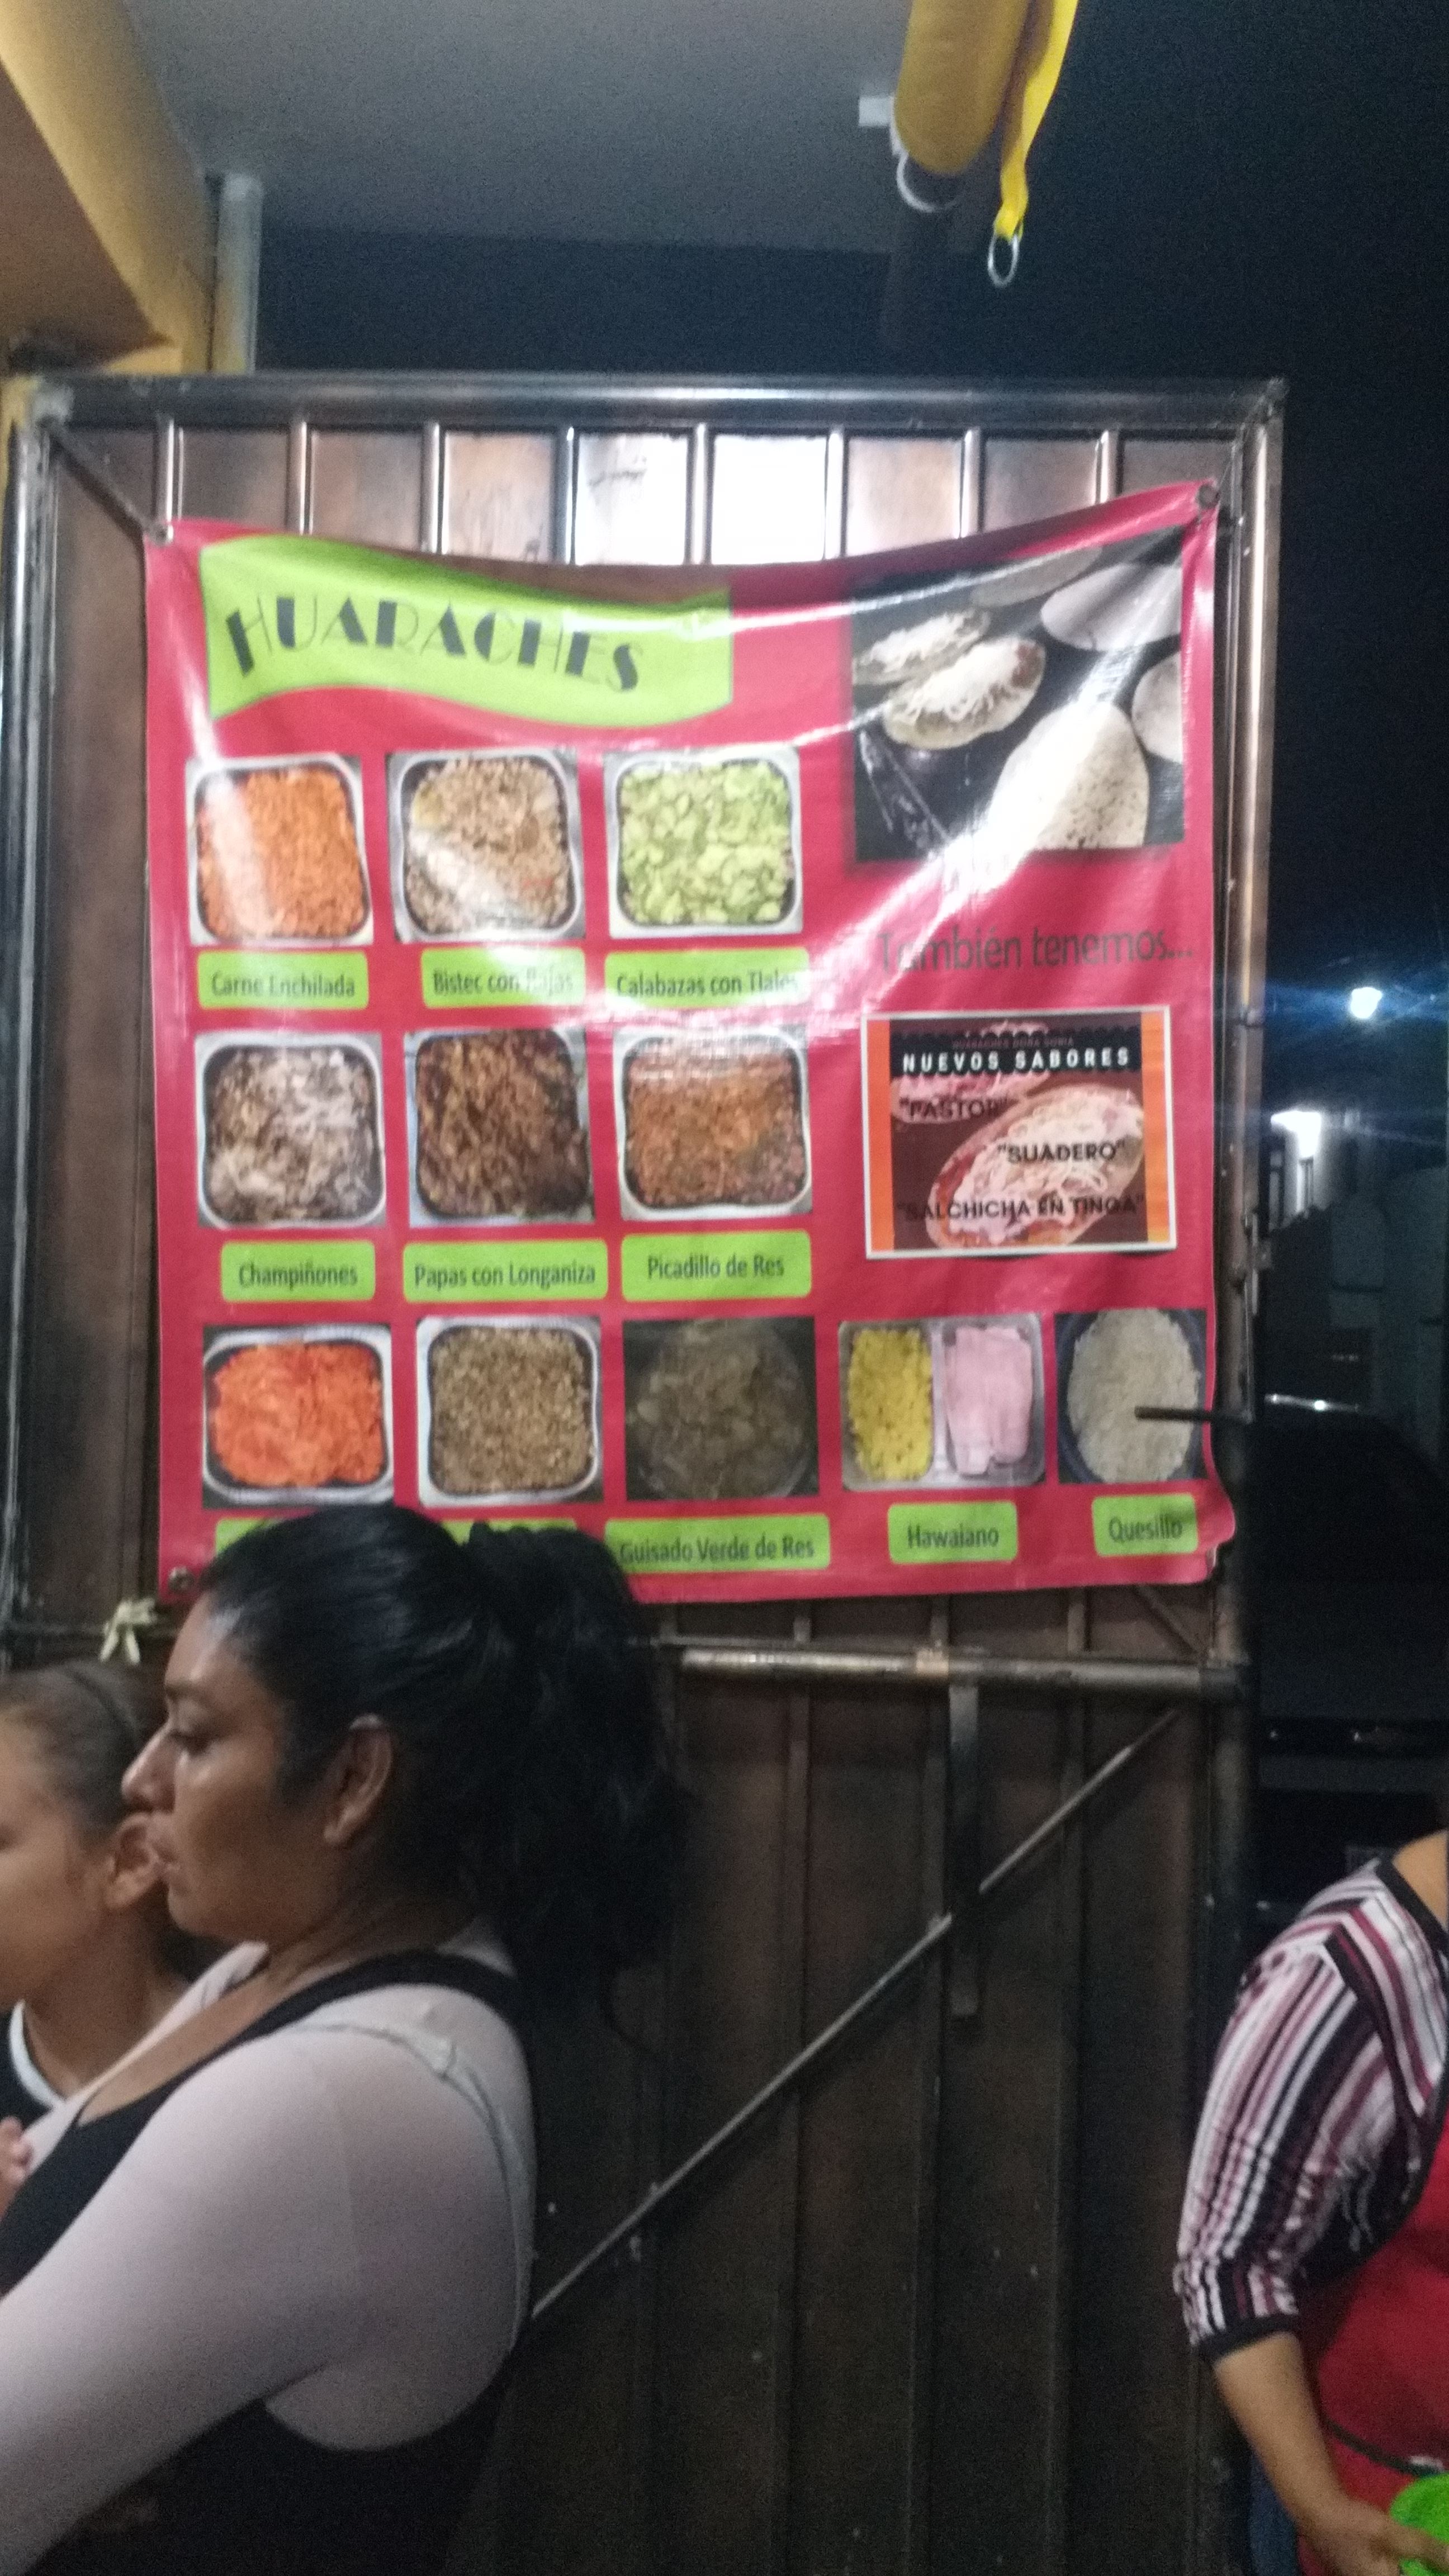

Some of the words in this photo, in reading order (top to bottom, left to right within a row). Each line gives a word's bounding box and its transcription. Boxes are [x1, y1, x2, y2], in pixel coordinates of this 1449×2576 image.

[226, 592, 644, 693] HUARACHES
[877, 925, 1022, 973] También
[211, 970, 263, 997] Carne
[269, 971, 355, 998] Enchilada
[434, 968, 481, 995] Bistec
[488, 972, 520, 993] con
[617, 970, 705, 997] Calabazas
[710, 975, 742, 996] con
[902, 1050, 1000, 1073] NUEVOS
[1015, 1046, 1130, 1070] SABORES
[997, 1140, 1126, 1163] "SUADERO"
[1036, 1195, 1066, 1216] EN
[239, 1261, 358, 1291] Champiñones
[415, 1263, 467, 1291] Papas
[472, 1266, 503, 1287] con
[509, 1259, 596, 1290] Longaniza
[648, 1253, 721, 1279] Picadillo
[726, 1253, 747, 1277] de
[754, 1254, 785, 1277] Res
[907, 1523, 999, 1549] Hawaiano
[1108, 1514, 1183, 1543] Quesillo
[619, 1537, 693, 1564] Guisado
[697, 1535, 750, 1561] Verde
[755, 1533, 776, 1559] de
[783, 1535, 815, 1559] Res
